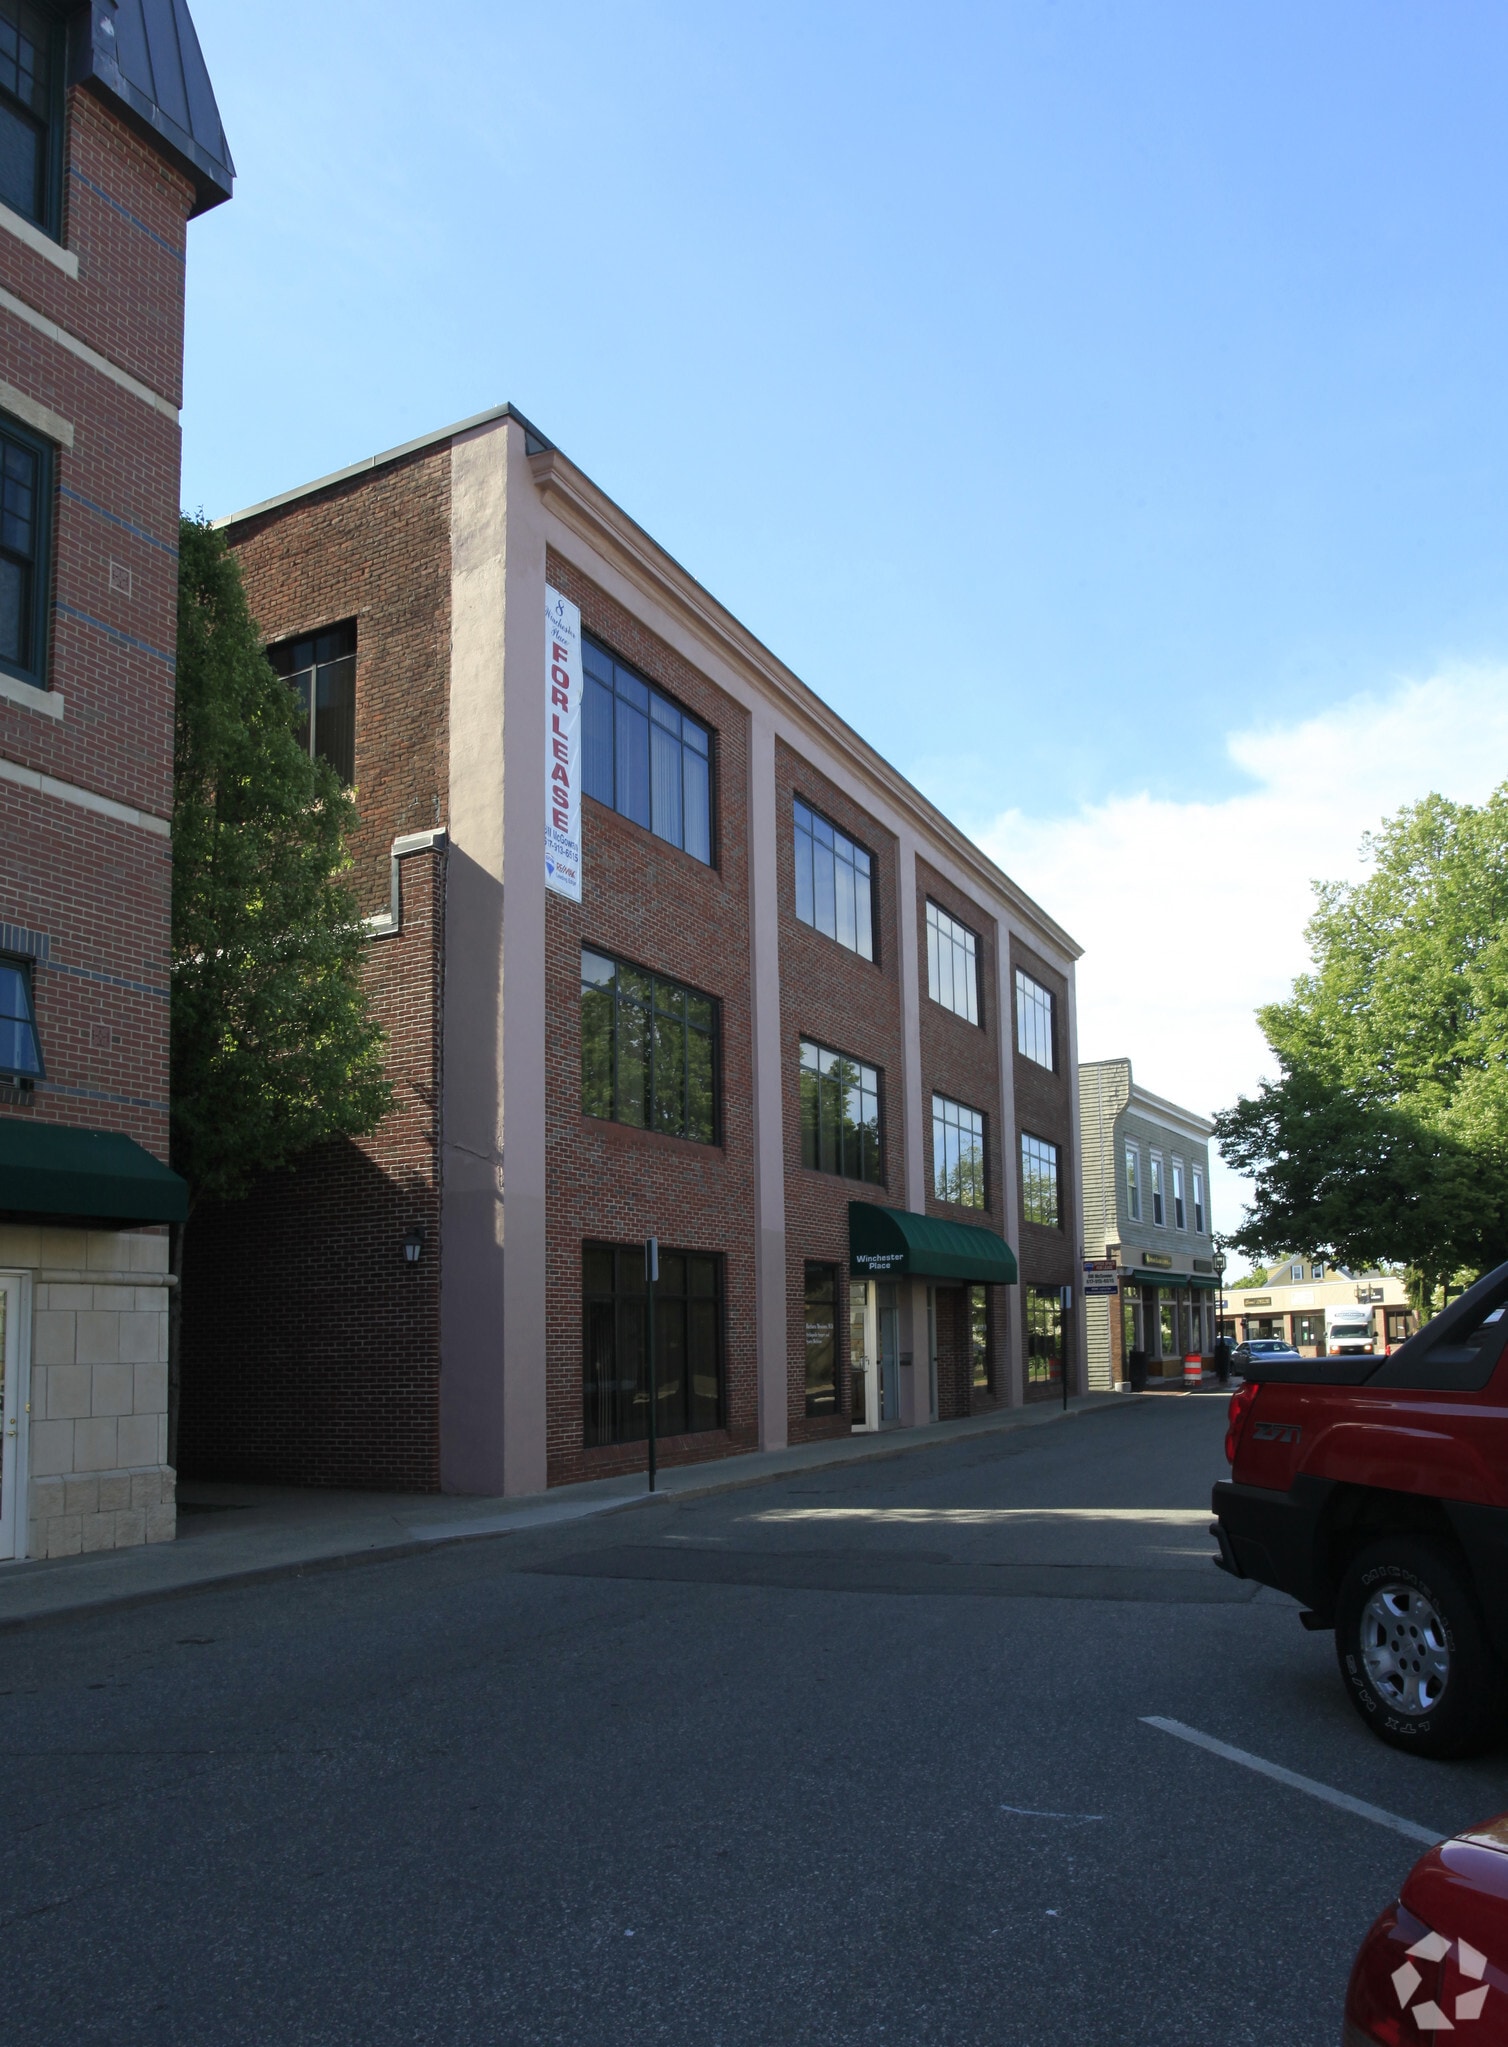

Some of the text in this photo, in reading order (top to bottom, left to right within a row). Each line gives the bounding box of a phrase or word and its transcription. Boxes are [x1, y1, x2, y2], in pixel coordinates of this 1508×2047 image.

[555, 599, 565, 617] 8
[551, 640, 570, 834] FOR LEASE
[856, 1254, 904, 1262] Winchester
